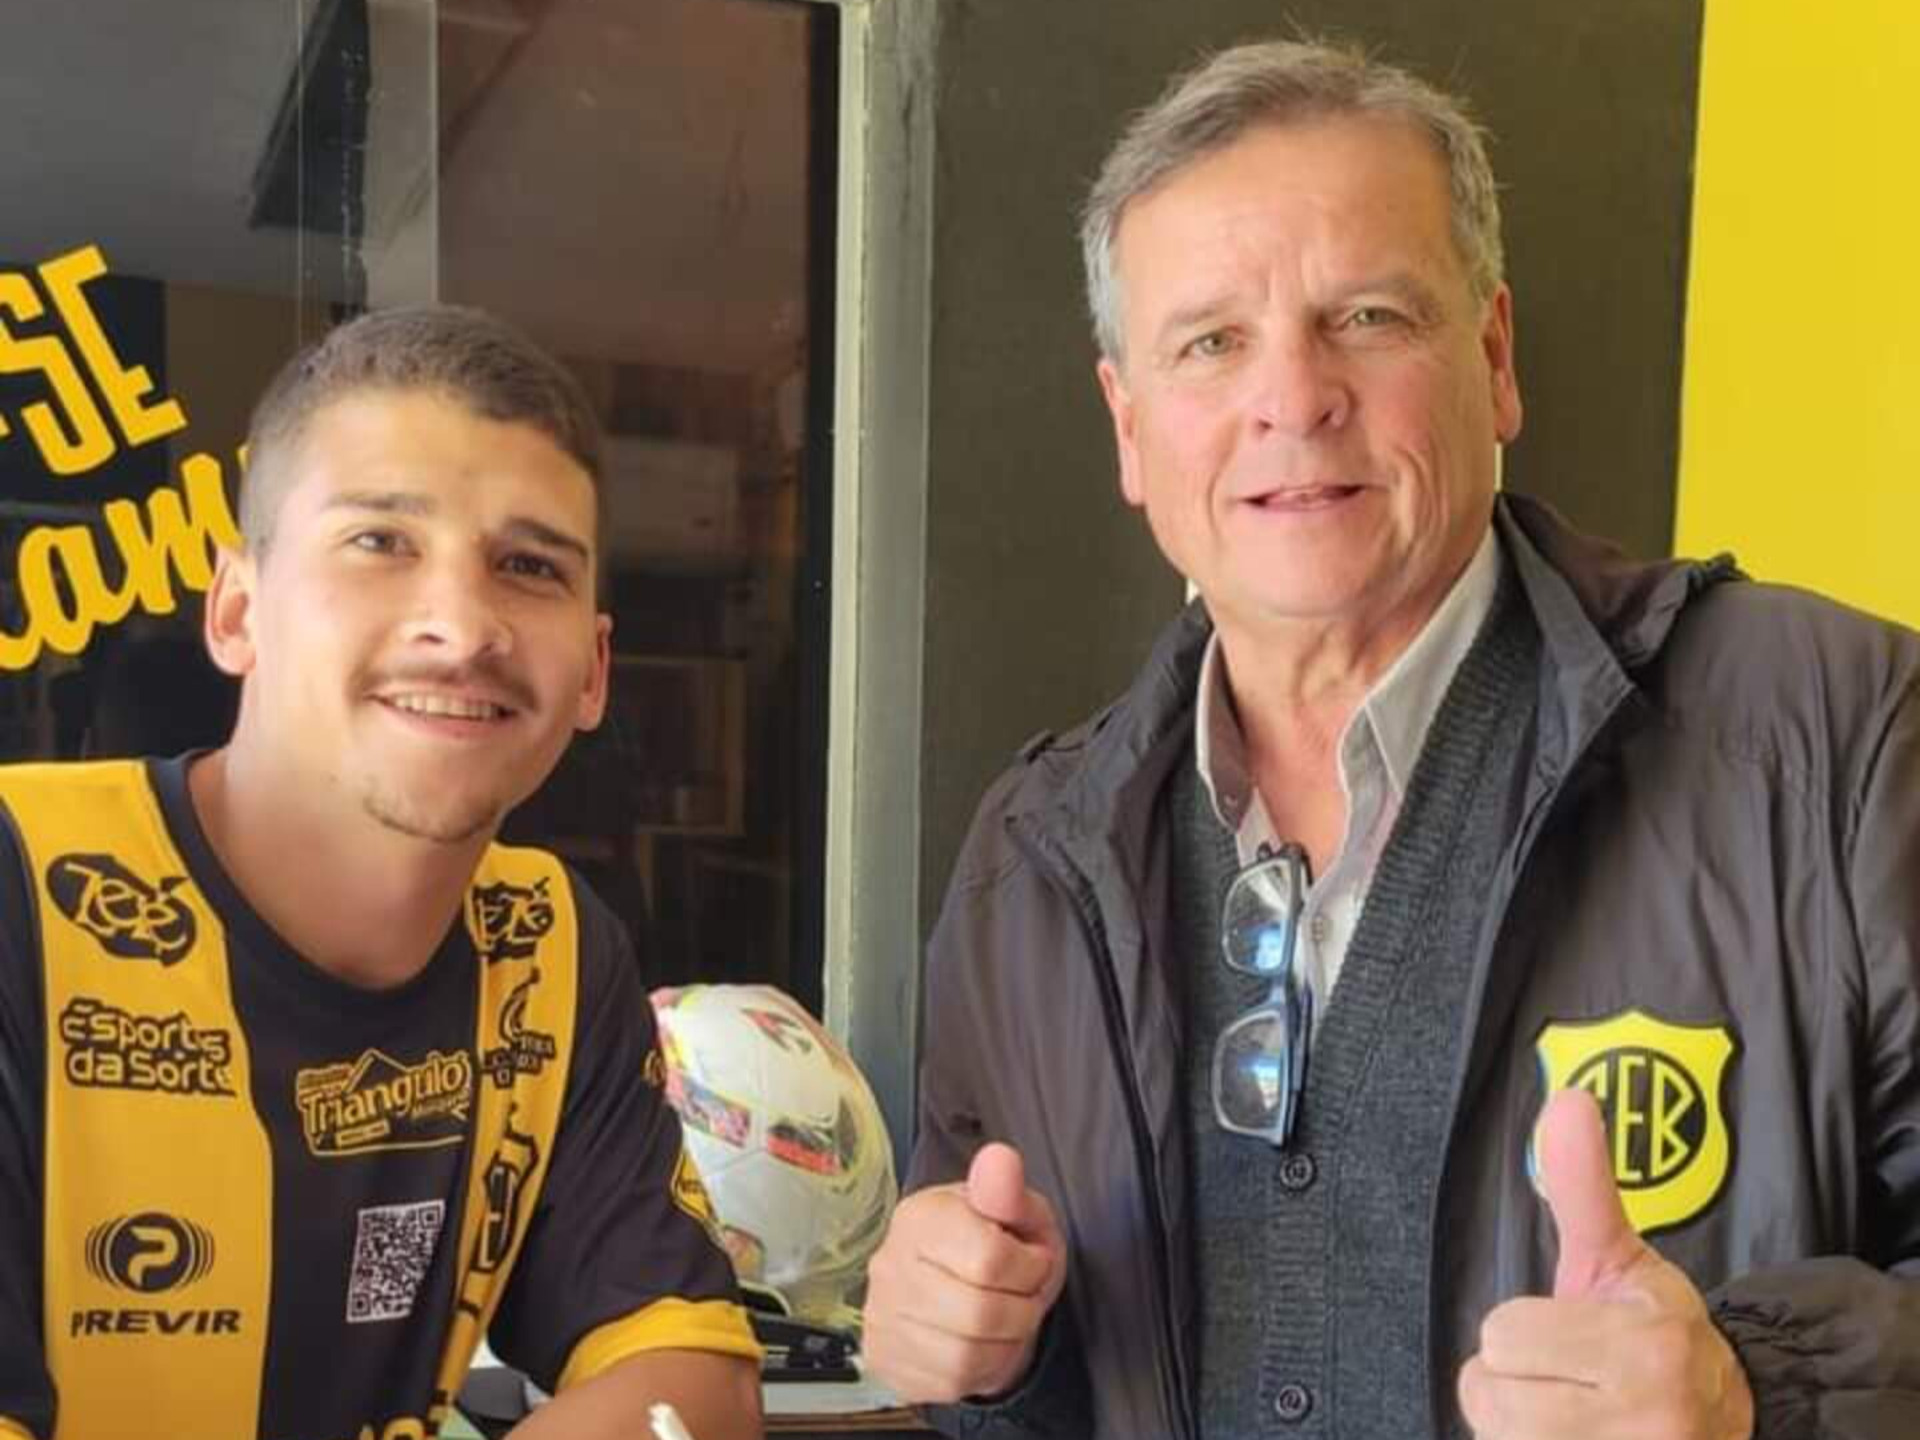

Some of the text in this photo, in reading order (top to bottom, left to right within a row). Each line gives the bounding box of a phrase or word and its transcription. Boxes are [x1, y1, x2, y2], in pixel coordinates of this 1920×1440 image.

[0, 245, 189, 474] SE
[1577, 1055, 1696, 1181] EB
[71, 1309, 241, 1338] PREVIR
